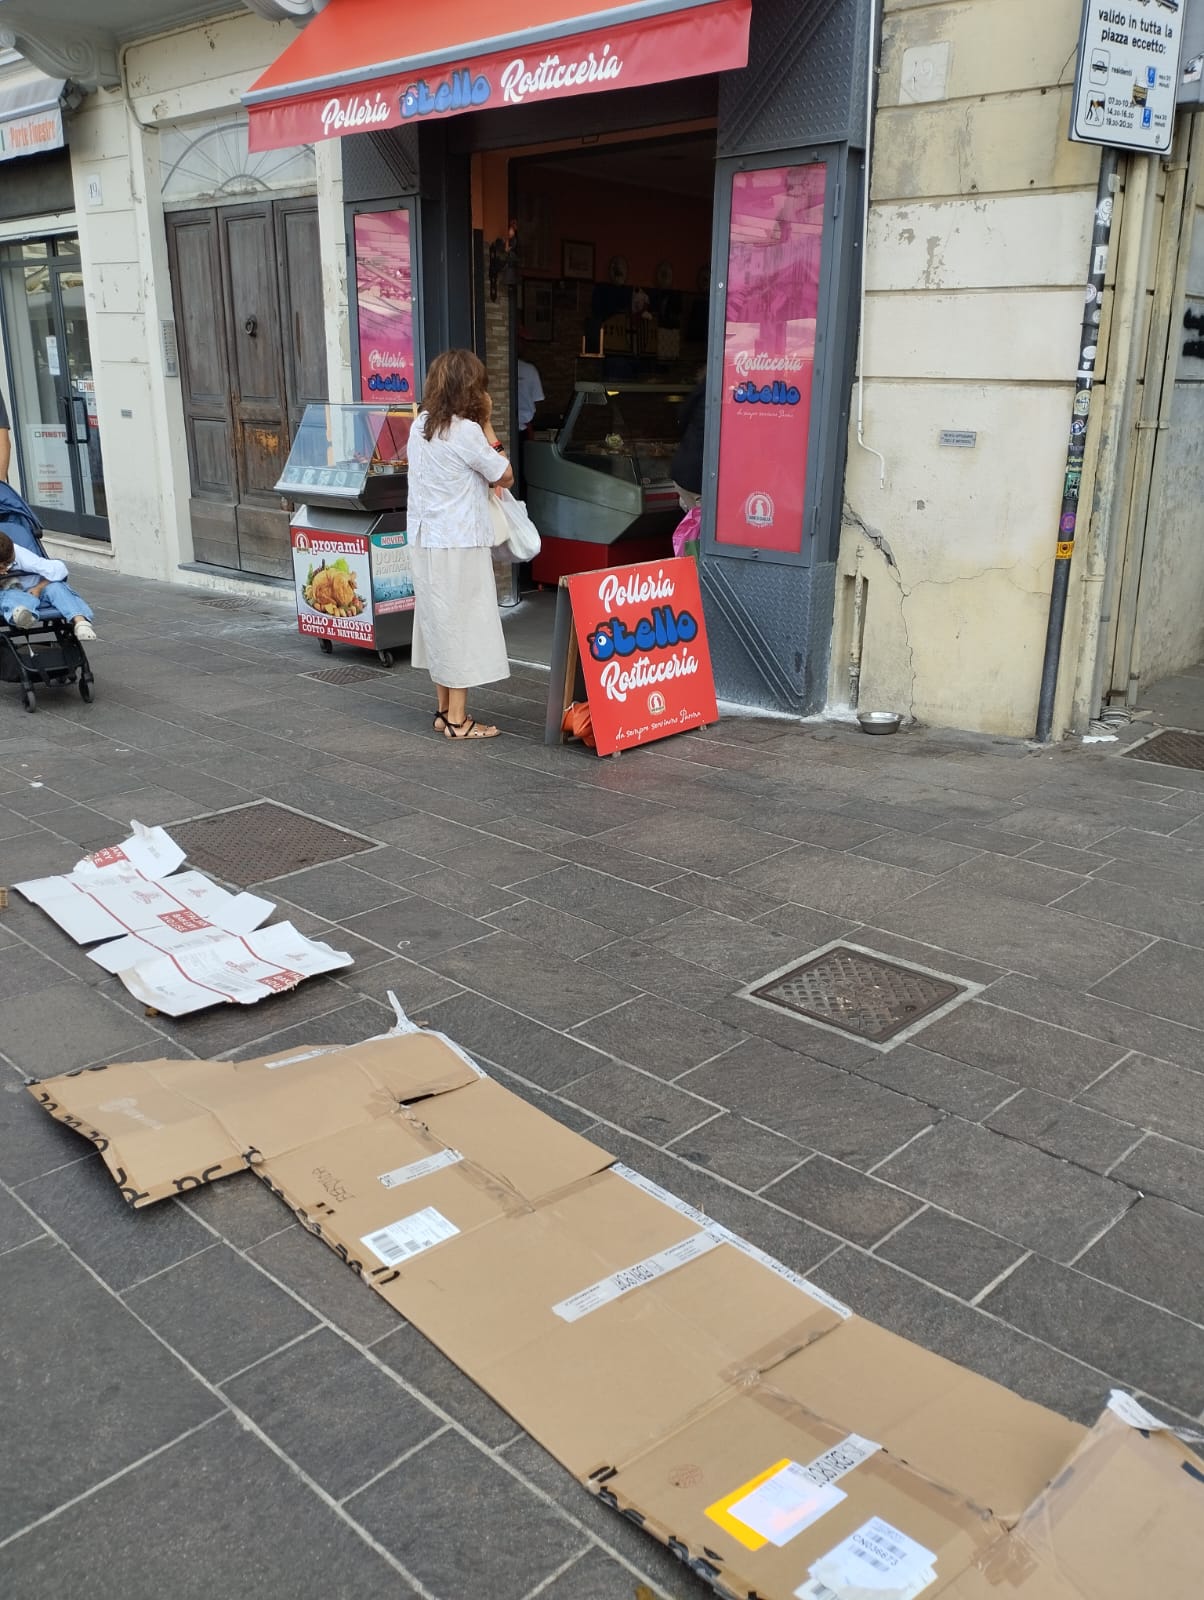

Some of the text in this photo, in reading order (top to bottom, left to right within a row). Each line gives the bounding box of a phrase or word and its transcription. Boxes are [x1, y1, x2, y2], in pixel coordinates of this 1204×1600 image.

[1098, 9, 1173, 38] valido in tutta la
[1101, 28, 1166, 54] piazza eccetto:
[1111, 66, 1133, 77] residenti
[321, 93, 390, 135] Polleria
[501, 45, 623, 103] Rosticceria
[369, 349, 406, 371] Polleria
[734, 350, 803, 377] Rosticceria
[311, 539, 366, 554] provami!
[599, 569, 674, 613] Polleria
[301, 614, 372, 633] POLLO ARROSTO
[302, 624, 373, 642] COTTO AL NATURALE
[600, 647, 699, 702] Rosticceria
